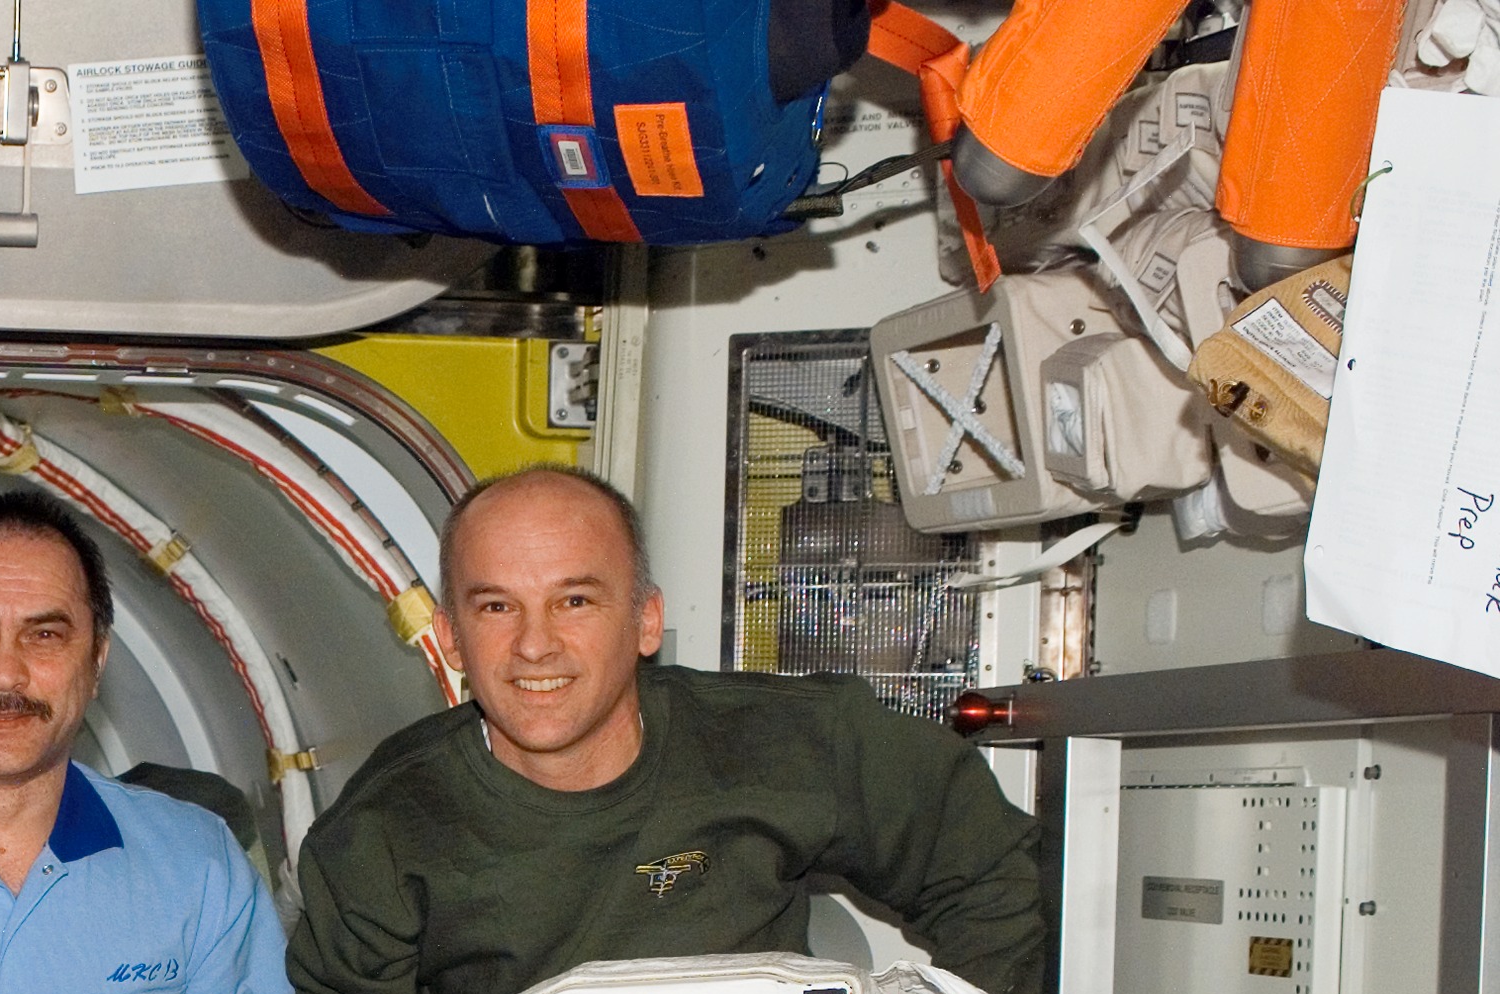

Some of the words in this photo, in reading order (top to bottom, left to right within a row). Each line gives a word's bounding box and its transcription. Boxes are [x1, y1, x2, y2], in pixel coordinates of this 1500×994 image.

[76, 66, 122, 77] AIRLOCK
[124, 61, 175, 73] STOWAGE
[862, 112, 882, 121] AND
[1448, 486, 1494, 550] Prep
